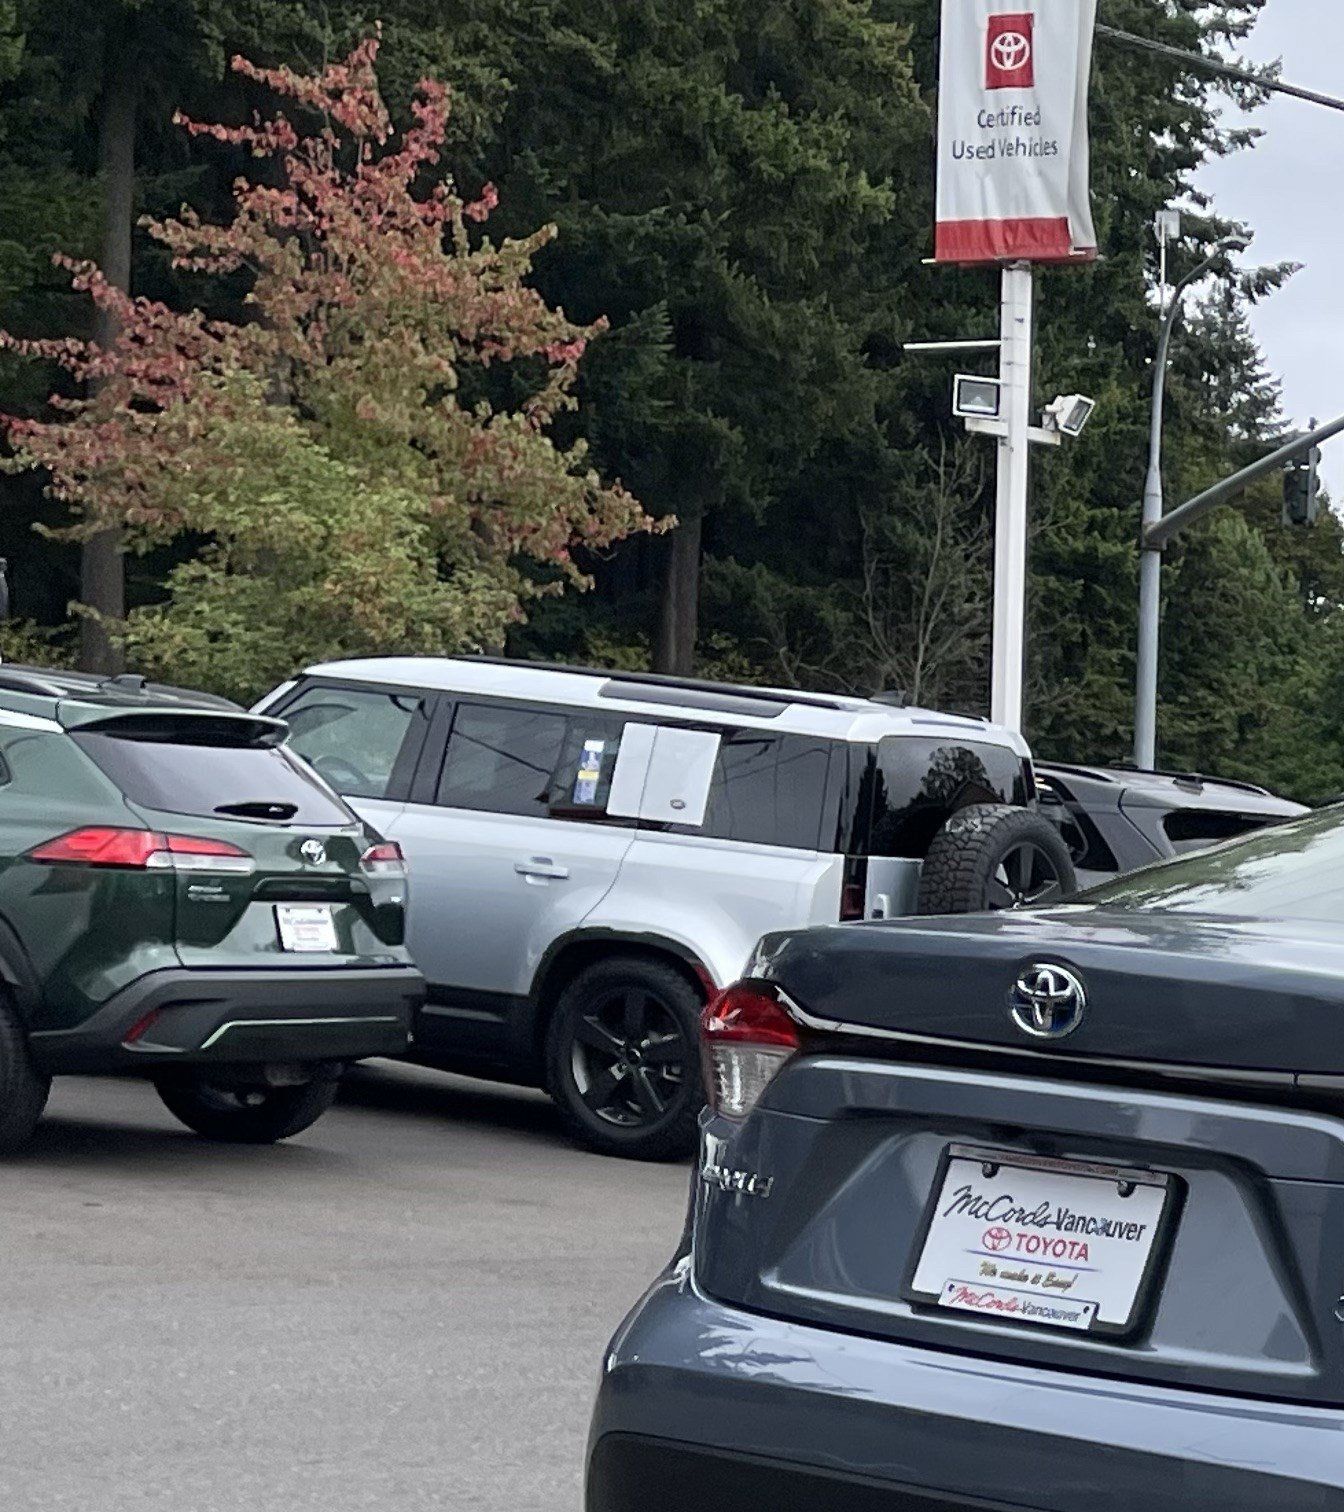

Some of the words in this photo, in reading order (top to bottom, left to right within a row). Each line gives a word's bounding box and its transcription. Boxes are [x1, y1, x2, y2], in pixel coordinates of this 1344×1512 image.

[977, 105, 1042, 129] Certified
[952, 140, 996, 160] Used
[999, 136, 1059, 159] Vehicles
[1016, 1231, 1090, 1262] TOYOTA
